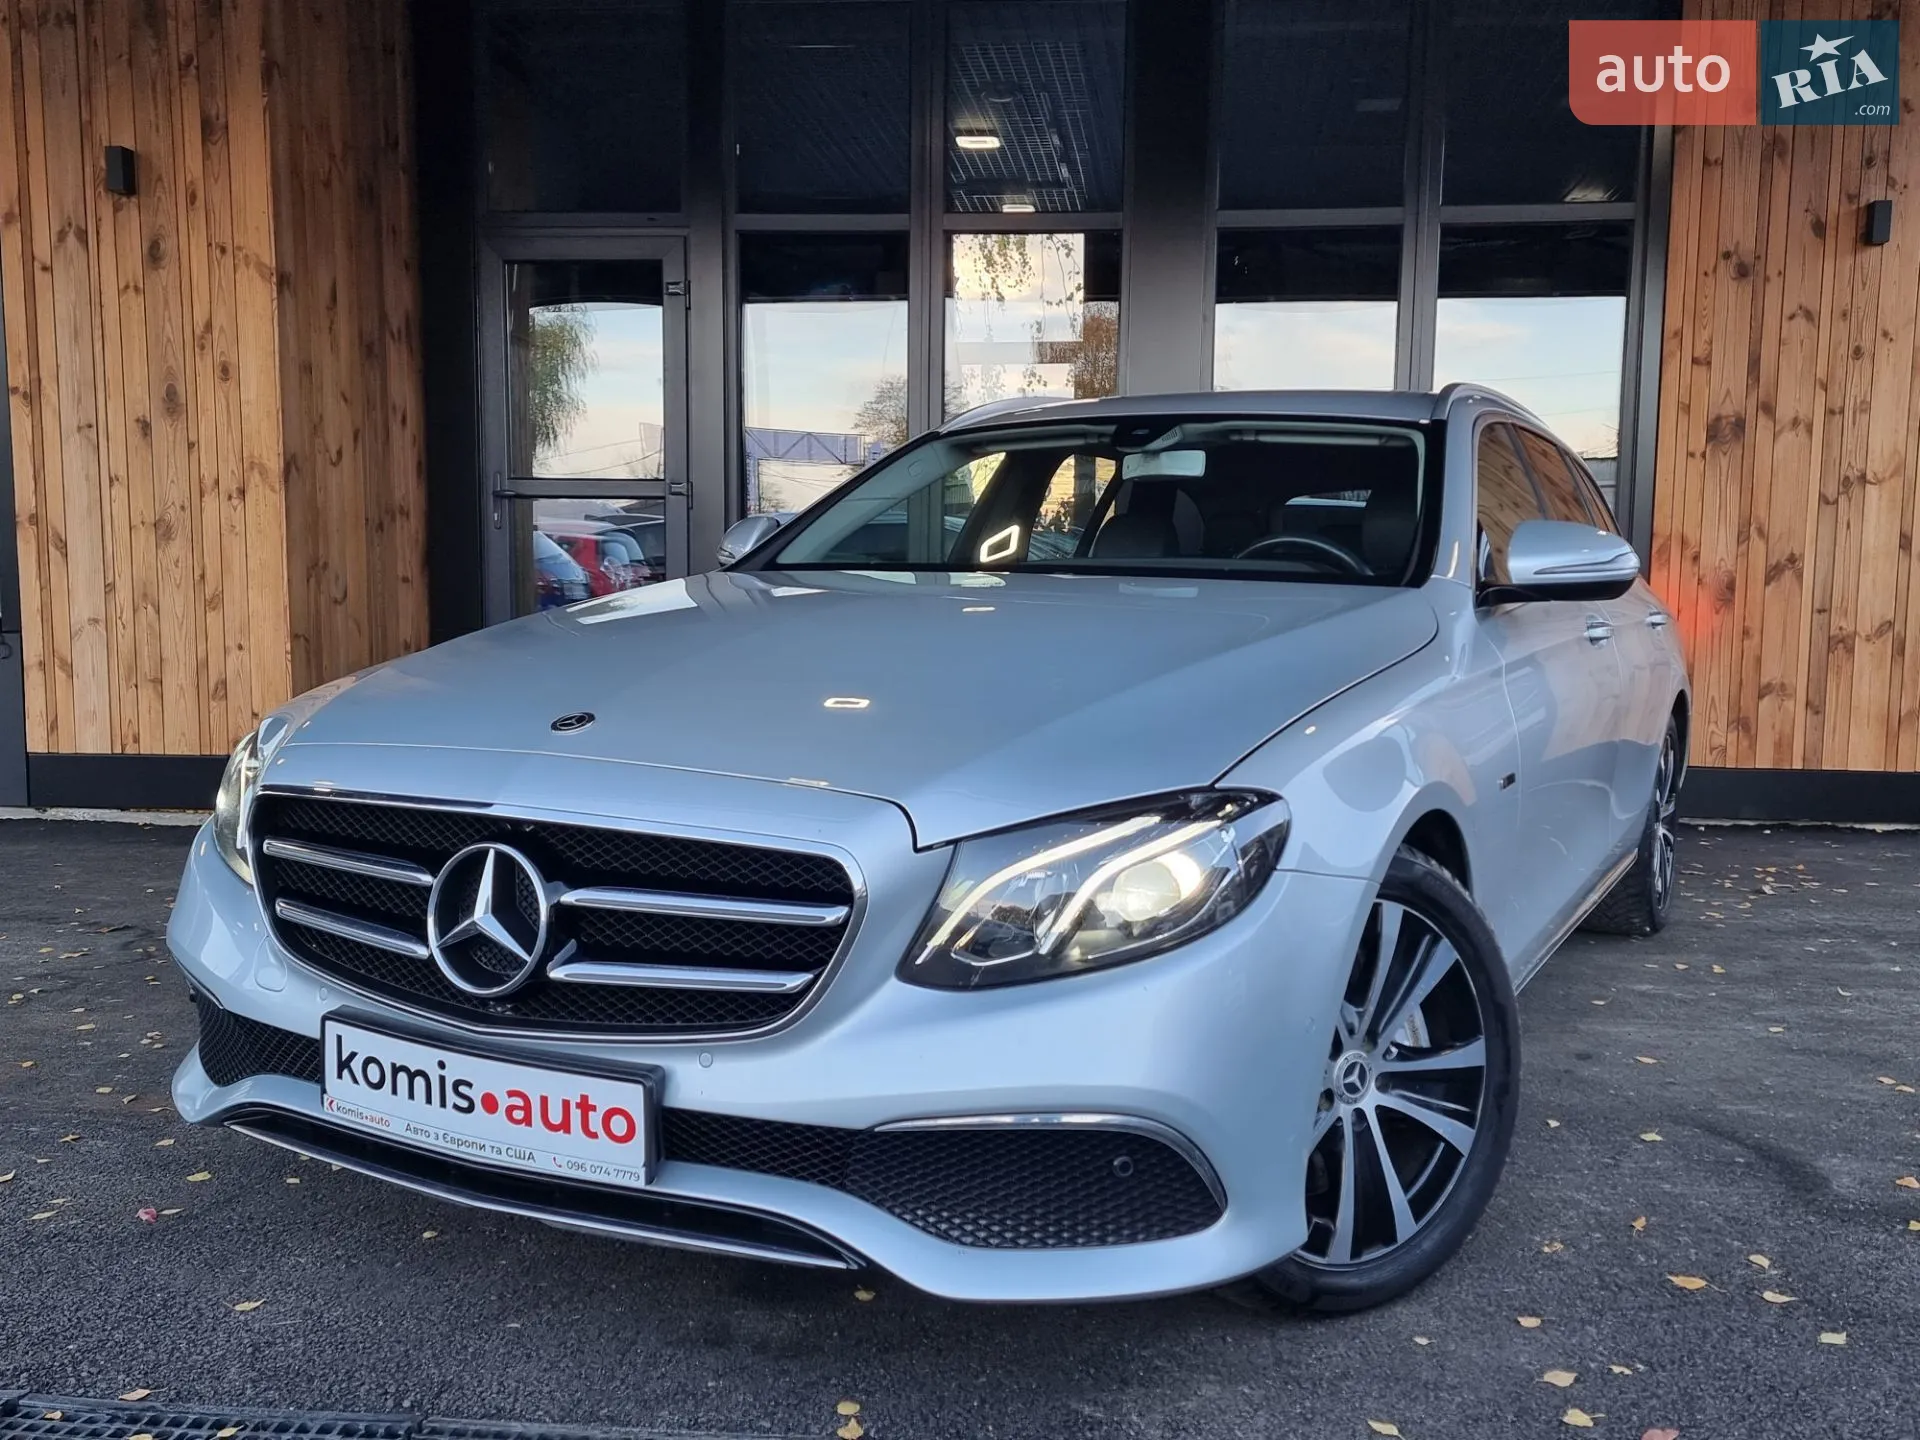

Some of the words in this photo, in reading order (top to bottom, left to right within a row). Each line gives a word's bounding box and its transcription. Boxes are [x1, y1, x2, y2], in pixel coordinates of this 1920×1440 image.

[405, 1122, 431, 1139] Авто
[433, 1131, 439, 1141] з
[442, 1132, 486, 1152] Європи
[489, 1145, 503, 1155] та
[505, 1147, 536, 1163] США
[566, 1160, 587, 1173] 096
[590, 1164, 611, 1177] 074
[613, 1168, 640, 1182] 7779
